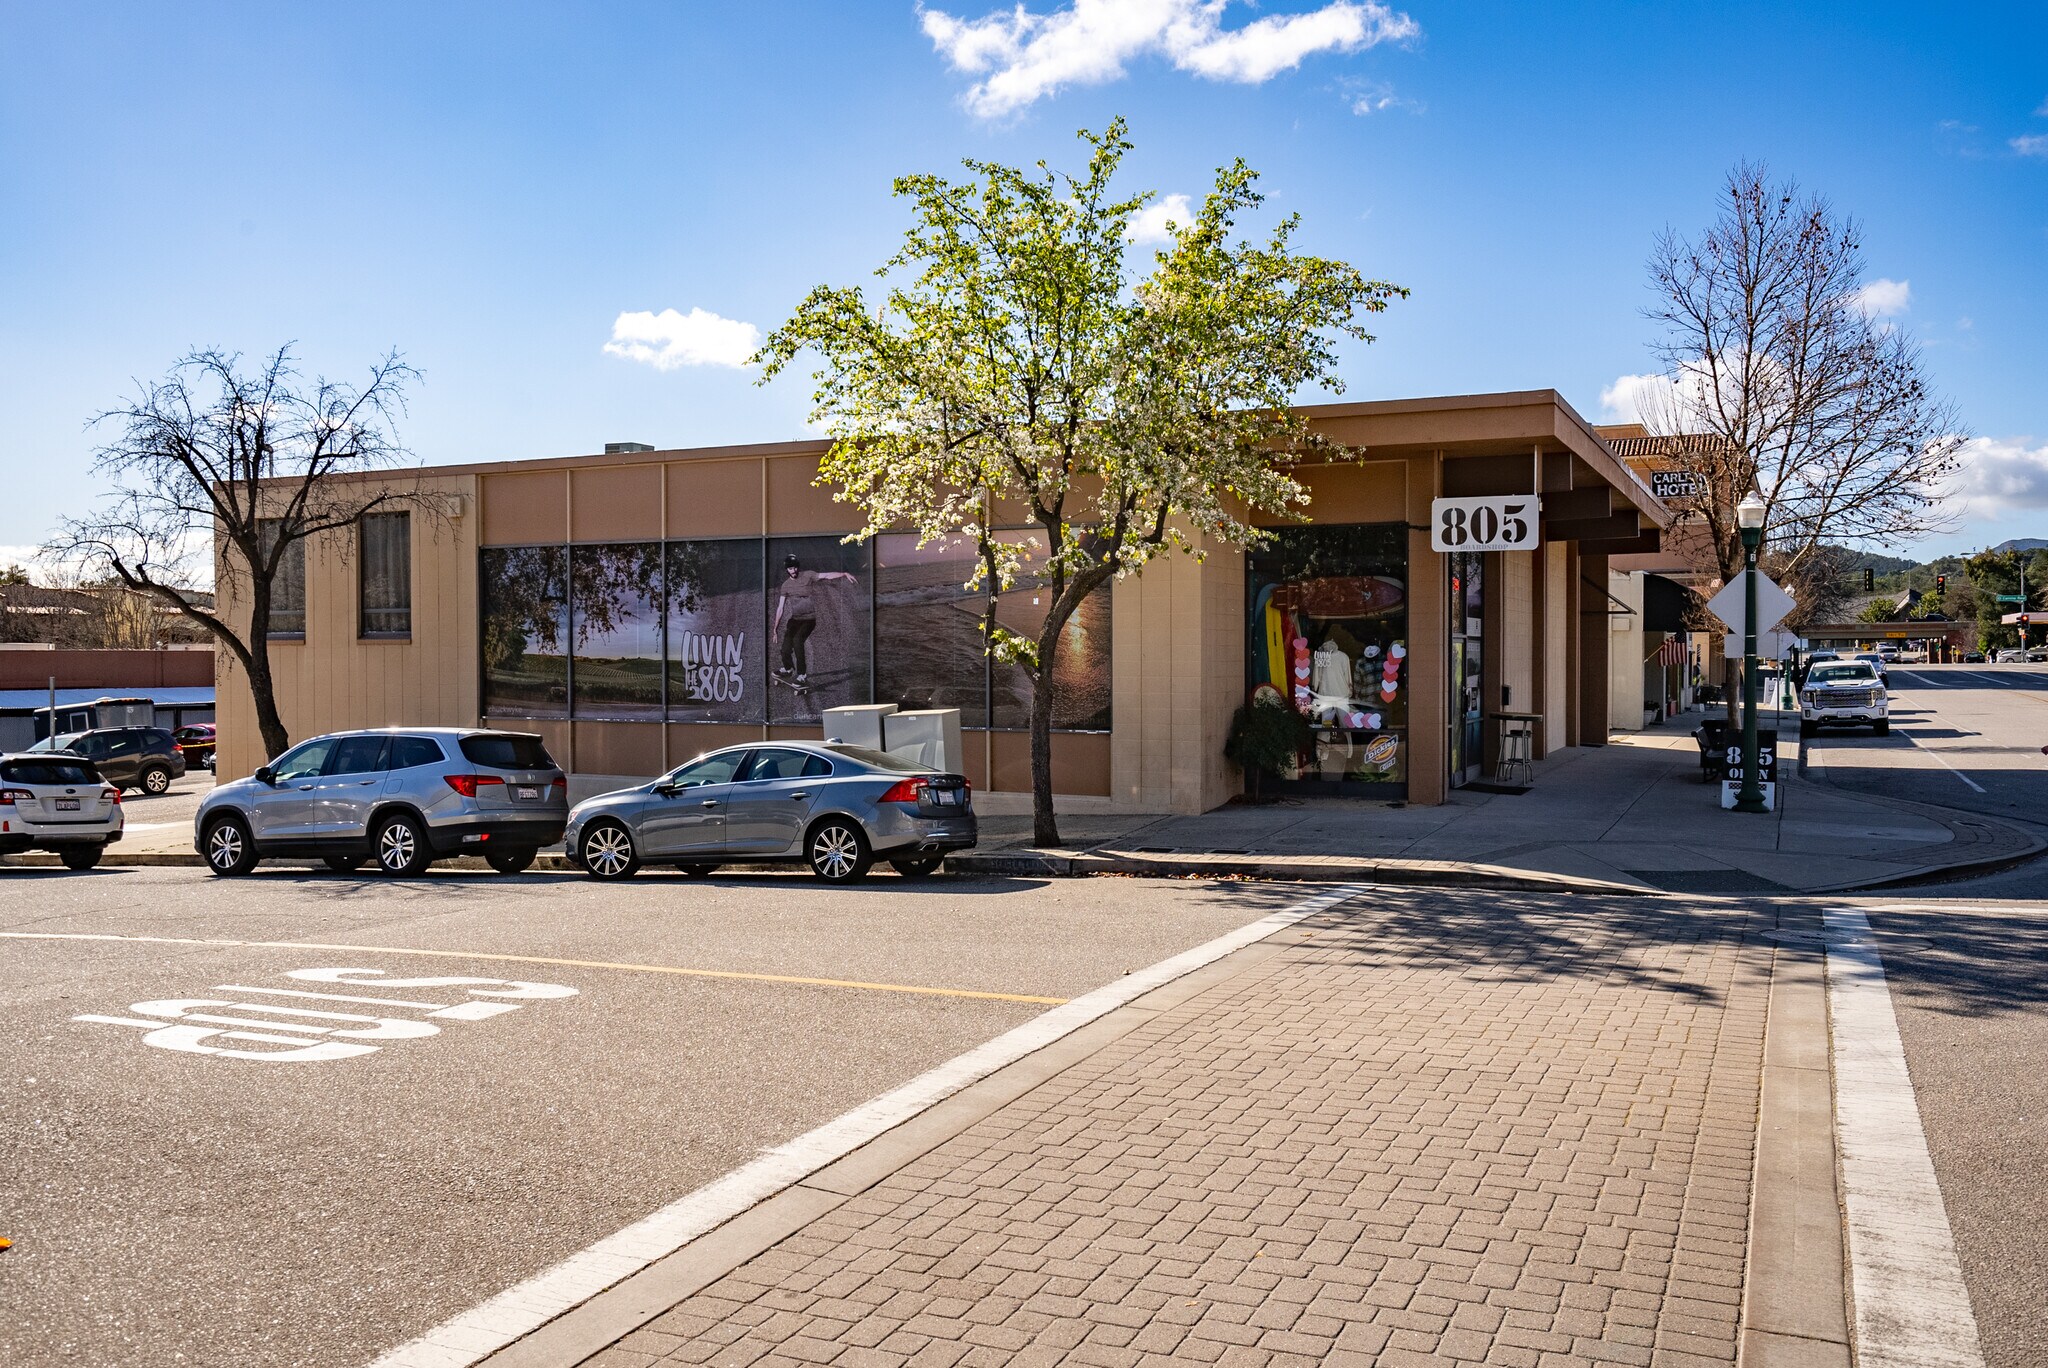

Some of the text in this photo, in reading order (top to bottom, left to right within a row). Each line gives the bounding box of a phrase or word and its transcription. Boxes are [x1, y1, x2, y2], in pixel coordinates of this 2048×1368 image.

[1653, 473, 1704, 484] CARLT
[1441, 504, 1528, 546] 805
[682, 631, 744, 669] LIVIN
[698, 659, 744, 702] 805
[1726, 746, 1773, 766] 85
[1728, 768, 1768, 780] ON
[72, 967, 580, 1062] STOP
